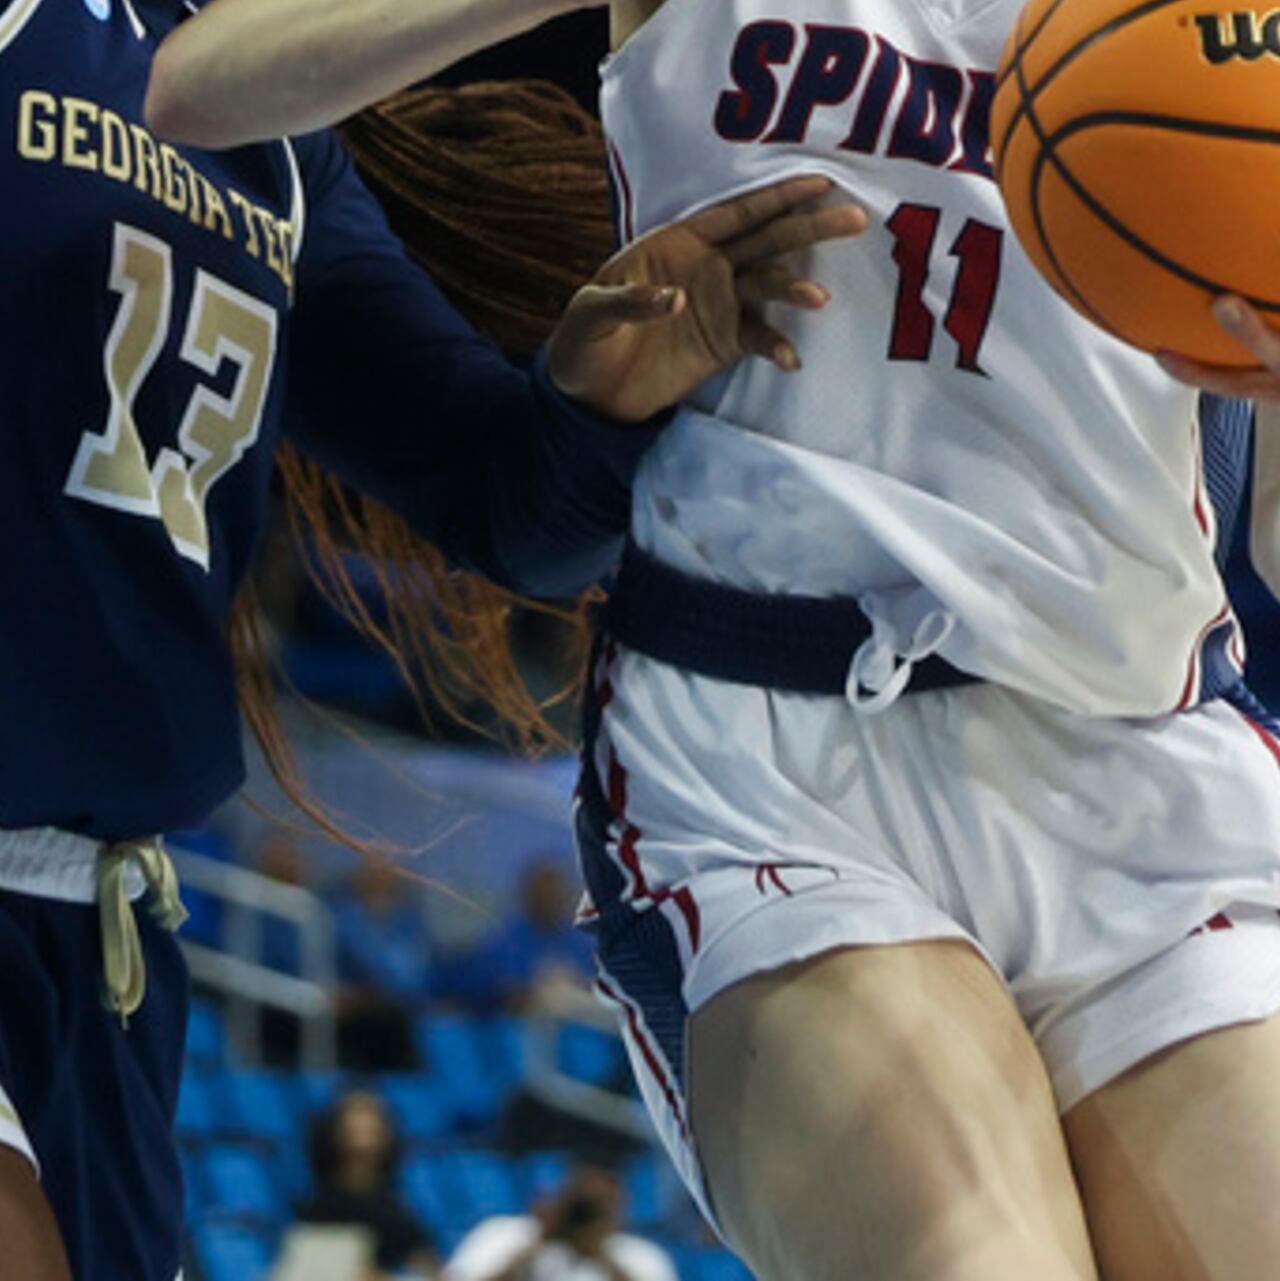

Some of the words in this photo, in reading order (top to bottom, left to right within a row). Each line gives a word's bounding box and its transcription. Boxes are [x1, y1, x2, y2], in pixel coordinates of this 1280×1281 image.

[17, 88, 234, 240] GEORGIA
[226, 187, 296, 310] TEC
[885, 202, 1004, 379] 11
[64, 222, 278, 573] 13
